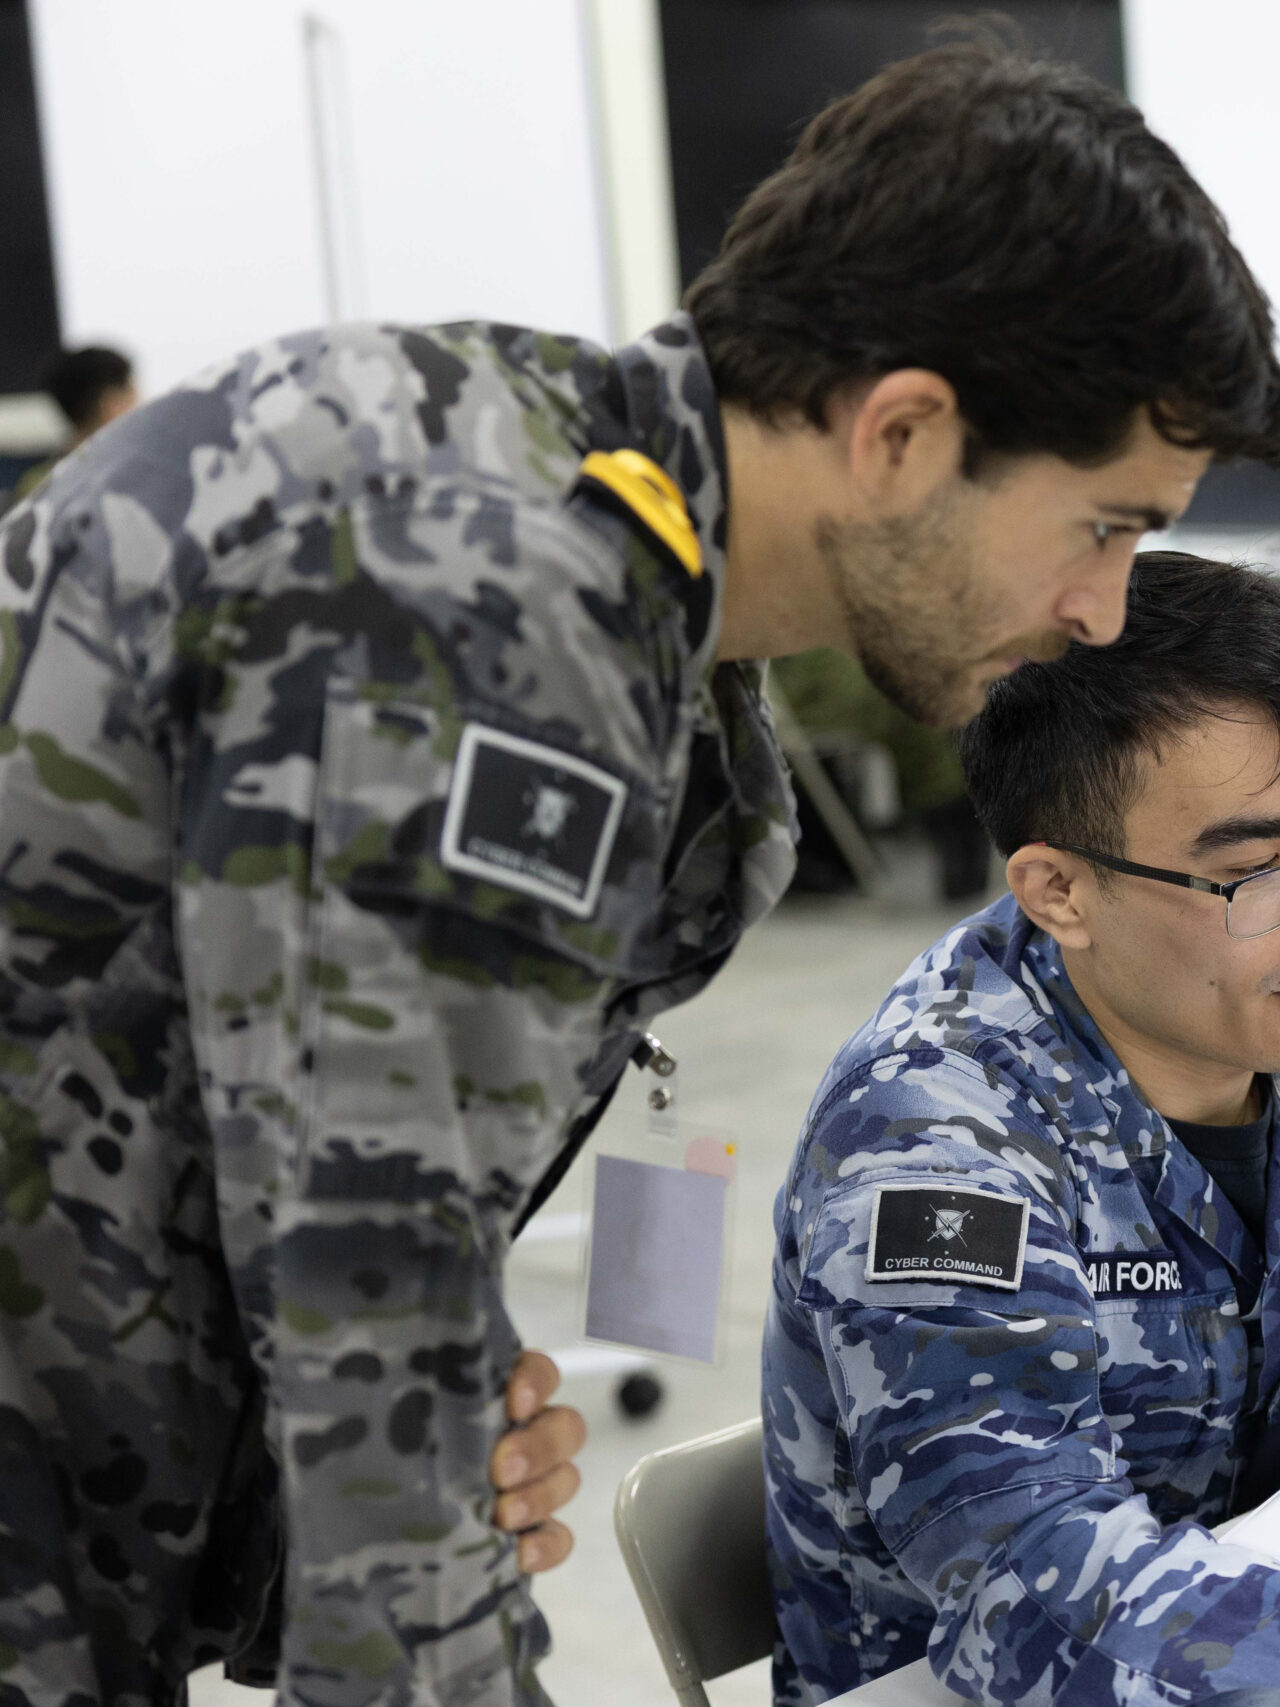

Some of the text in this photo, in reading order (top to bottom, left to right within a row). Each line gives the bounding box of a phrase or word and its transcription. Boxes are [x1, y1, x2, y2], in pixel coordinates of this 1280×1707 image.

[885, 1257, 1003, 1277] CYBER COMMAND
[1116, 1260, 1183, 1292] FORC
